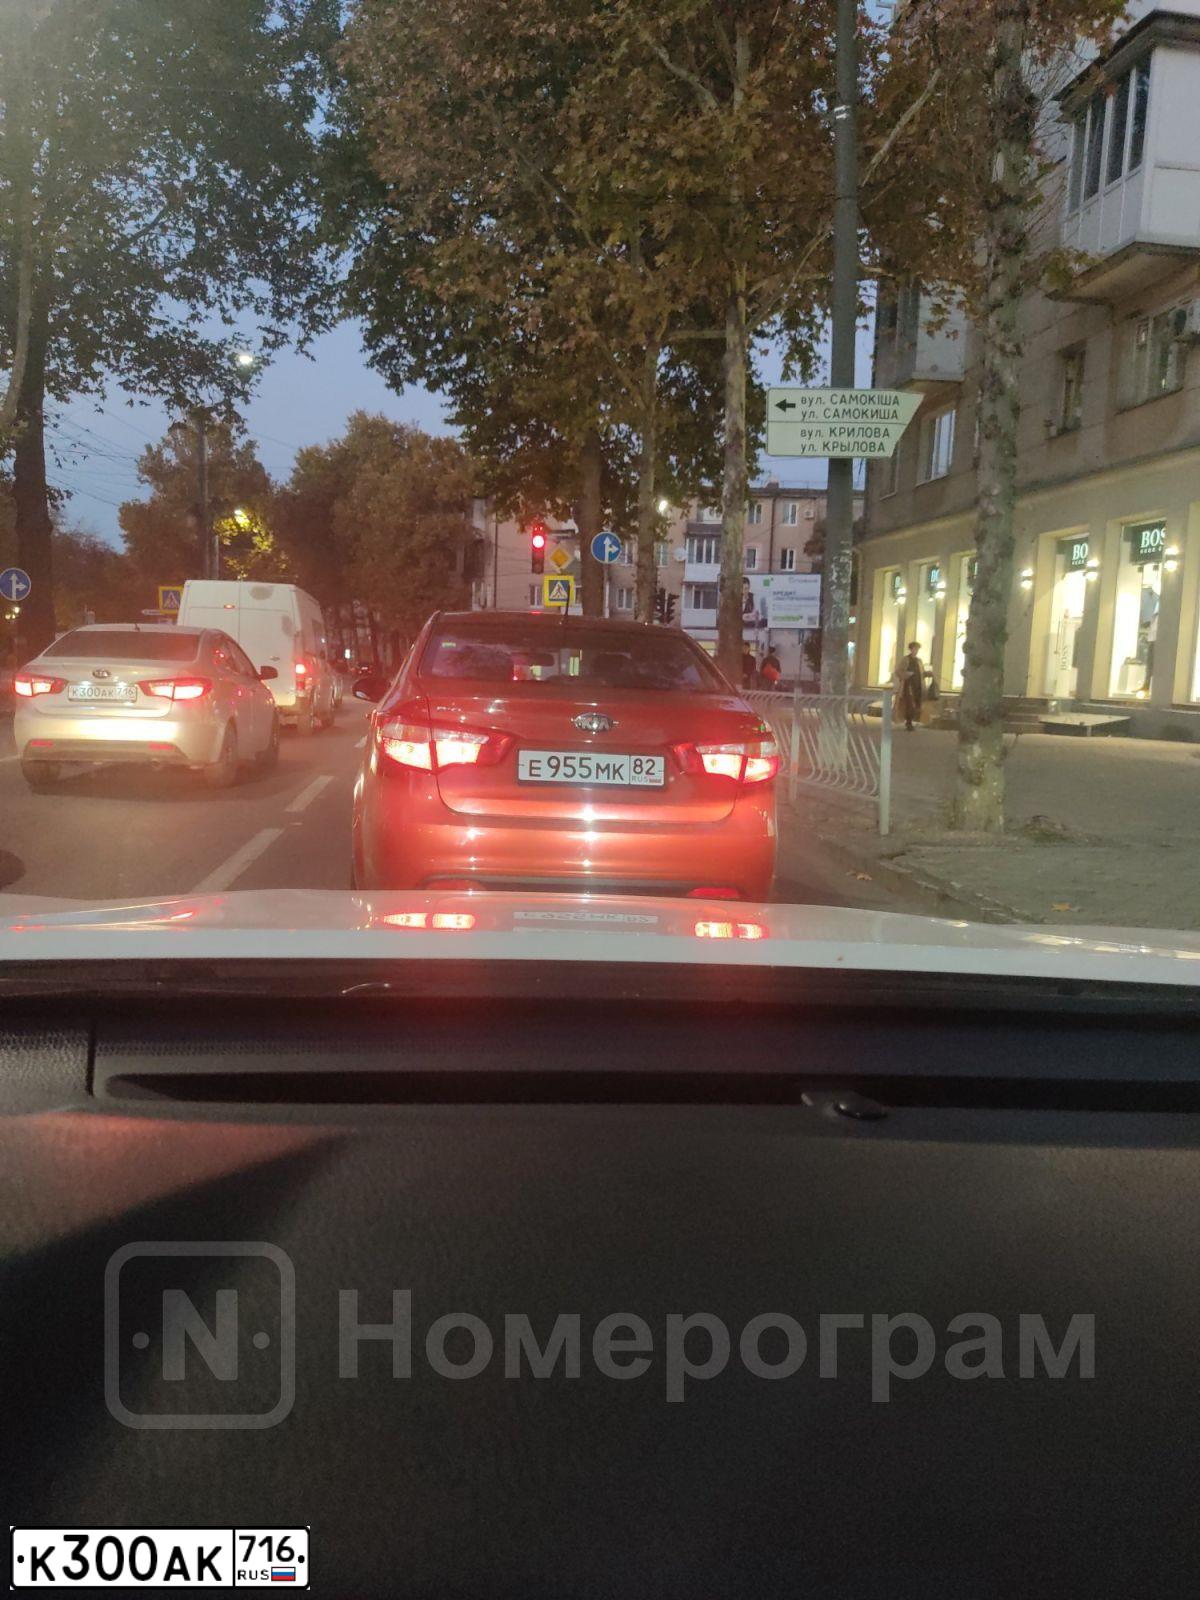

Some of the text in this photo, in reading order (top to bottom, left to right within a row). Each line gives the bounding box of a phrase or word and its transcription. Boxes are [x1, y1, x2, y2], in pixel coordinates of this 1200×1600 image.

[800, 393, 900, 406] вул. САМОКІША
[801, 408, 899, 421] ул. САМОКИША
[800, 427, 890, 439] вул. КРИЛОВА
[800, 441, 885, 454] ул. КРЫЛОВА
[1140, 528, 1166, 548] BOS
[632, 757, 656, 776] 82
